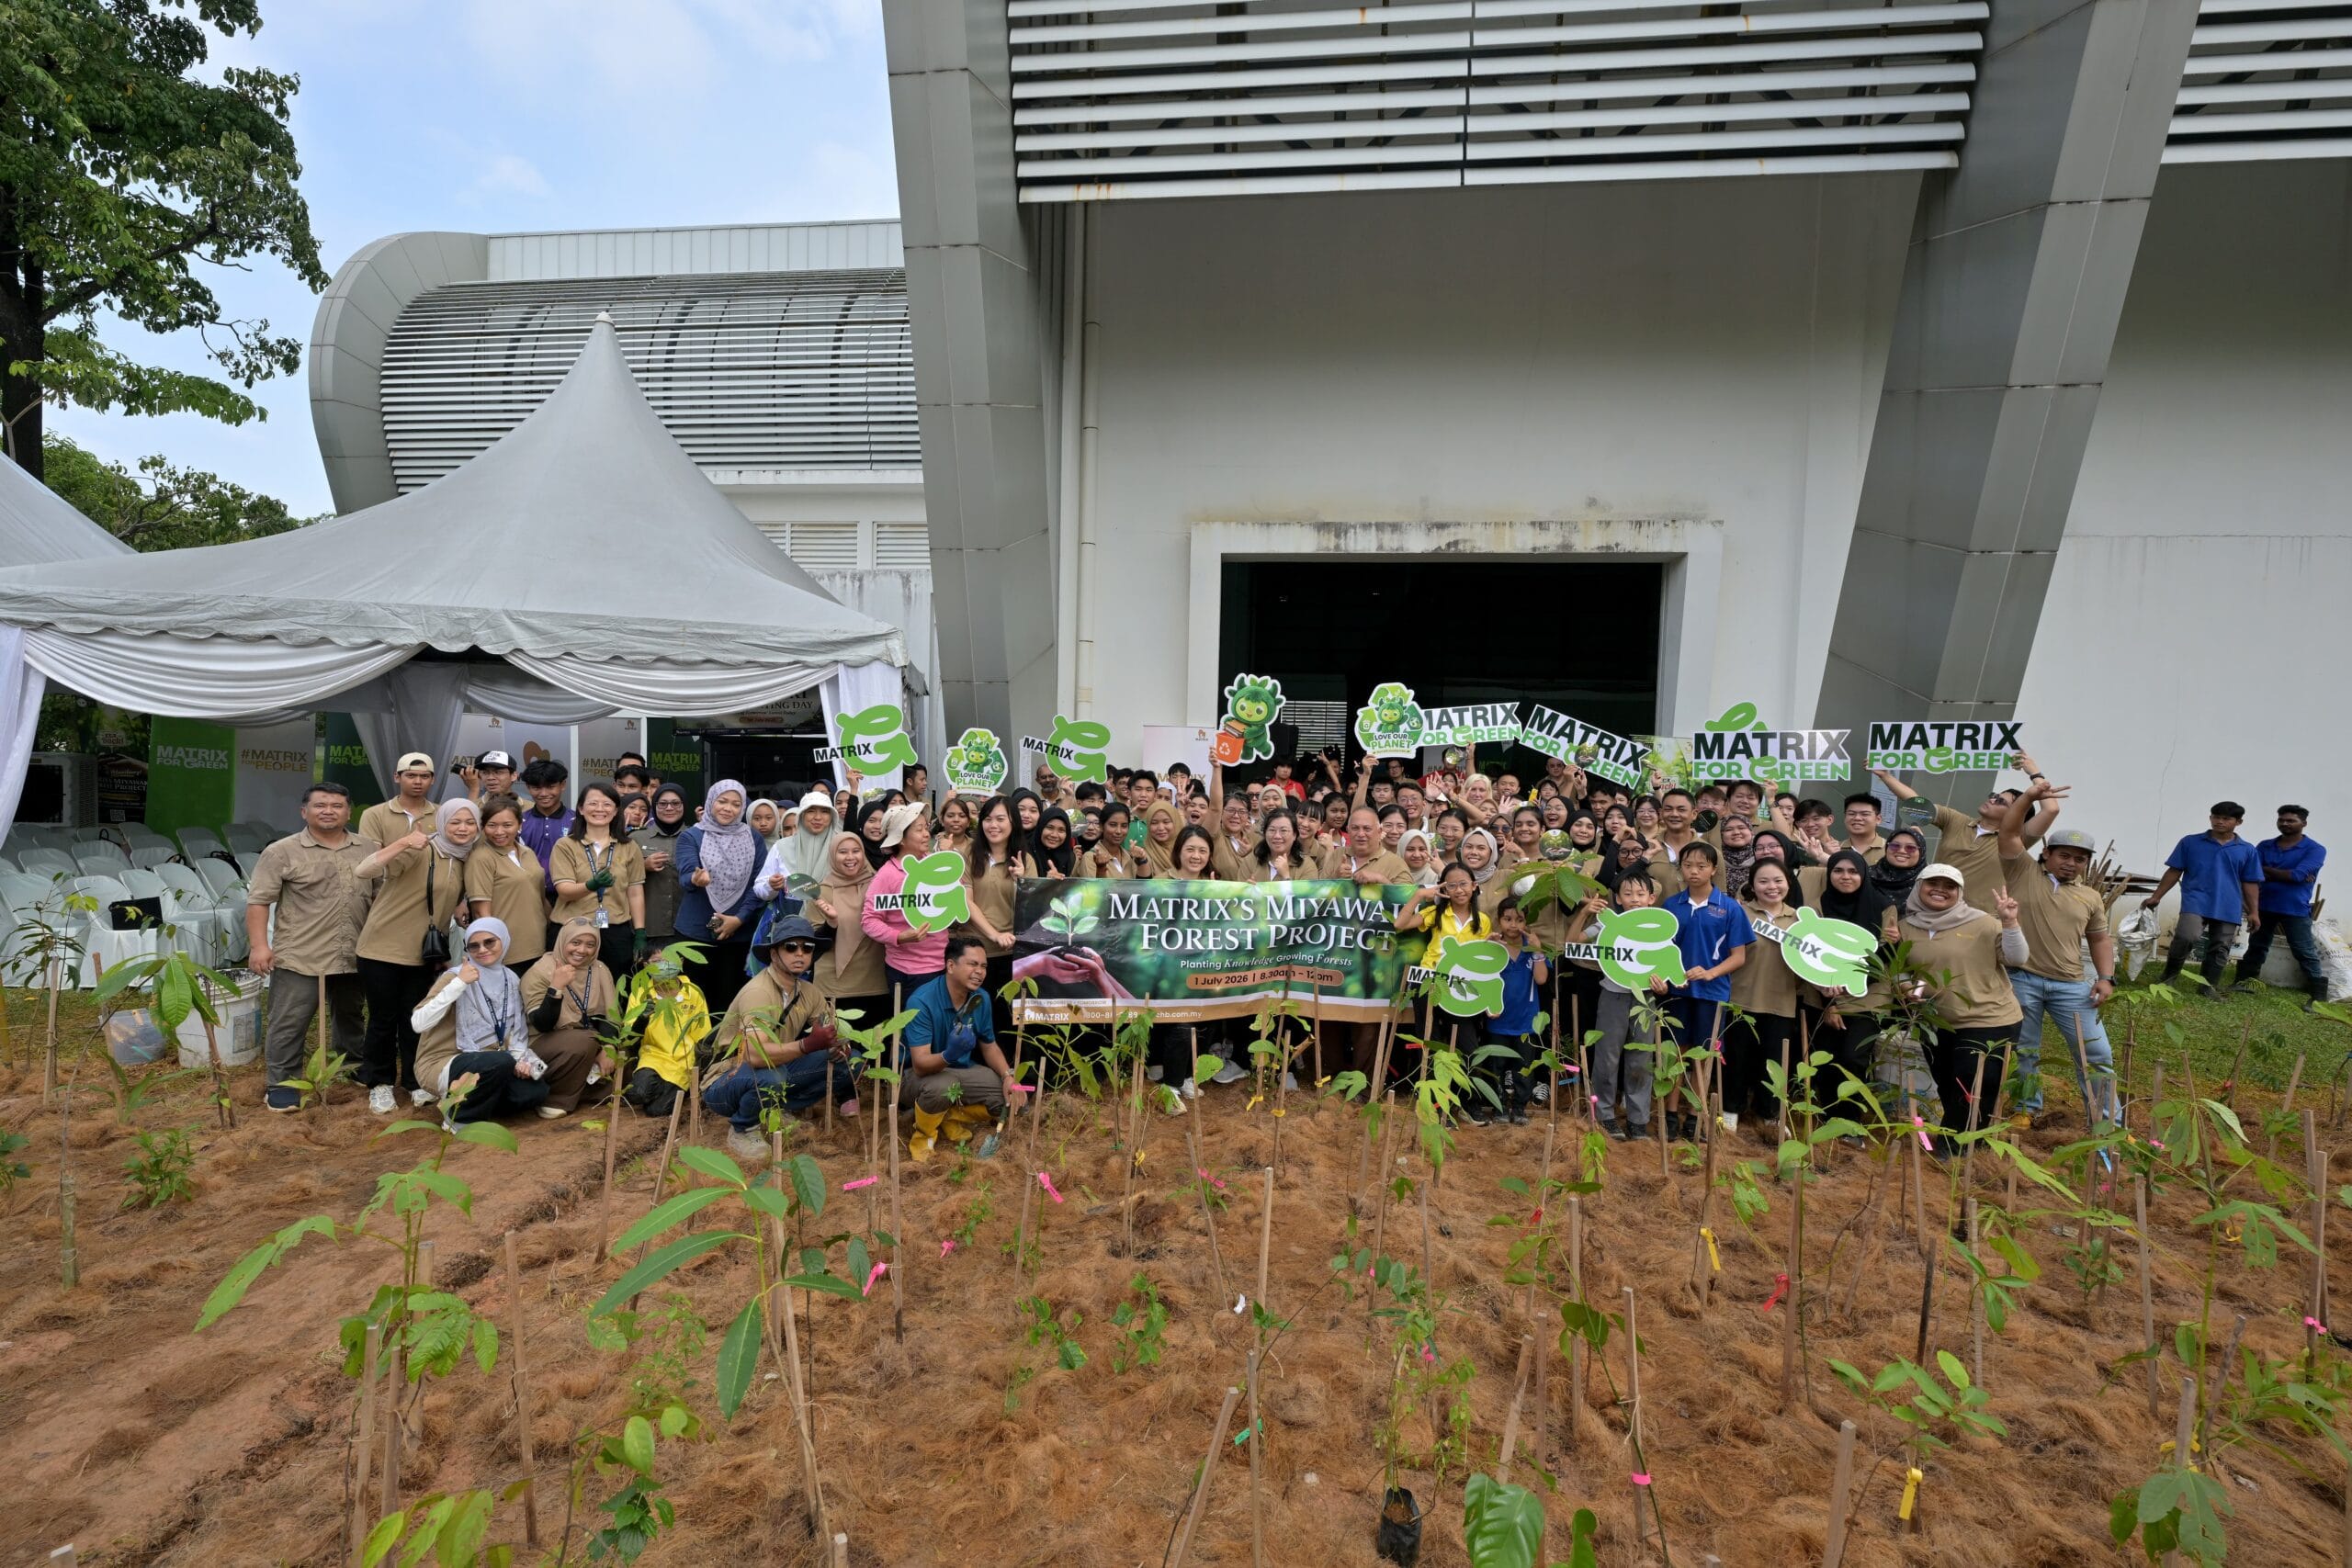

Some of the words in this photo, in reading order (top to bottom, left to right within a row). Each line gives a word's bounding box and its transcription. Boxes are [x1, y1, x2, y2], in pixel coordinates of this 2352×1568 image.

[793, 701, 813, 709] DAY
[1371, 739, 1412, 750] PLANET
[1422, 731, 1448, 745] OR
[1452, 725, 1521, 747] GREEN
[1521, 728, 1561, 756] FOR
[1529, 706, 1652, 772] MATRIX
[1869, 722, 2023, 750] MATRIX
[156, 745, 229, 761] MATRIX
[241, 749, 308, 762] #MATRIX
[815, 742, 872, 762] MATRIX
[1023, 736, 1074, 761] MATRIX
[1693, 732, 1850, 761] MATRIX
[156, 757, 181, 766] FOR
[184, 757, 229, 770] GREEN
[255, 761, 308, 772] PEOPLE
[1693, 761, 1744, 779] FOR
[1749, 755, 1850, 782] GREEN
[1868, 752, 1918, 769] FOR
[956, 777, 994, 788] PLANET
[876, 894, 932, 909] MATRIX
[1139, 923, 1259, 951] FOREST
[1267, 923, 1397, 952] PROJECT
[1753, 919, 1822, 958] MATRIX
[1181, 960, 1222, 971] Planting
[1224, 955, 1274, 968] Knowledge
[1276, 952, 1314, 964] Growing
[1316, 953, 1353, 966] Forests
[1566, 943, 1634, 963] MATRIX
[1201, 976, 1223, 987] July
[1225, 974, 1249, 984] 2026
[1035, 1012, 1069, 1021] MATRIX
